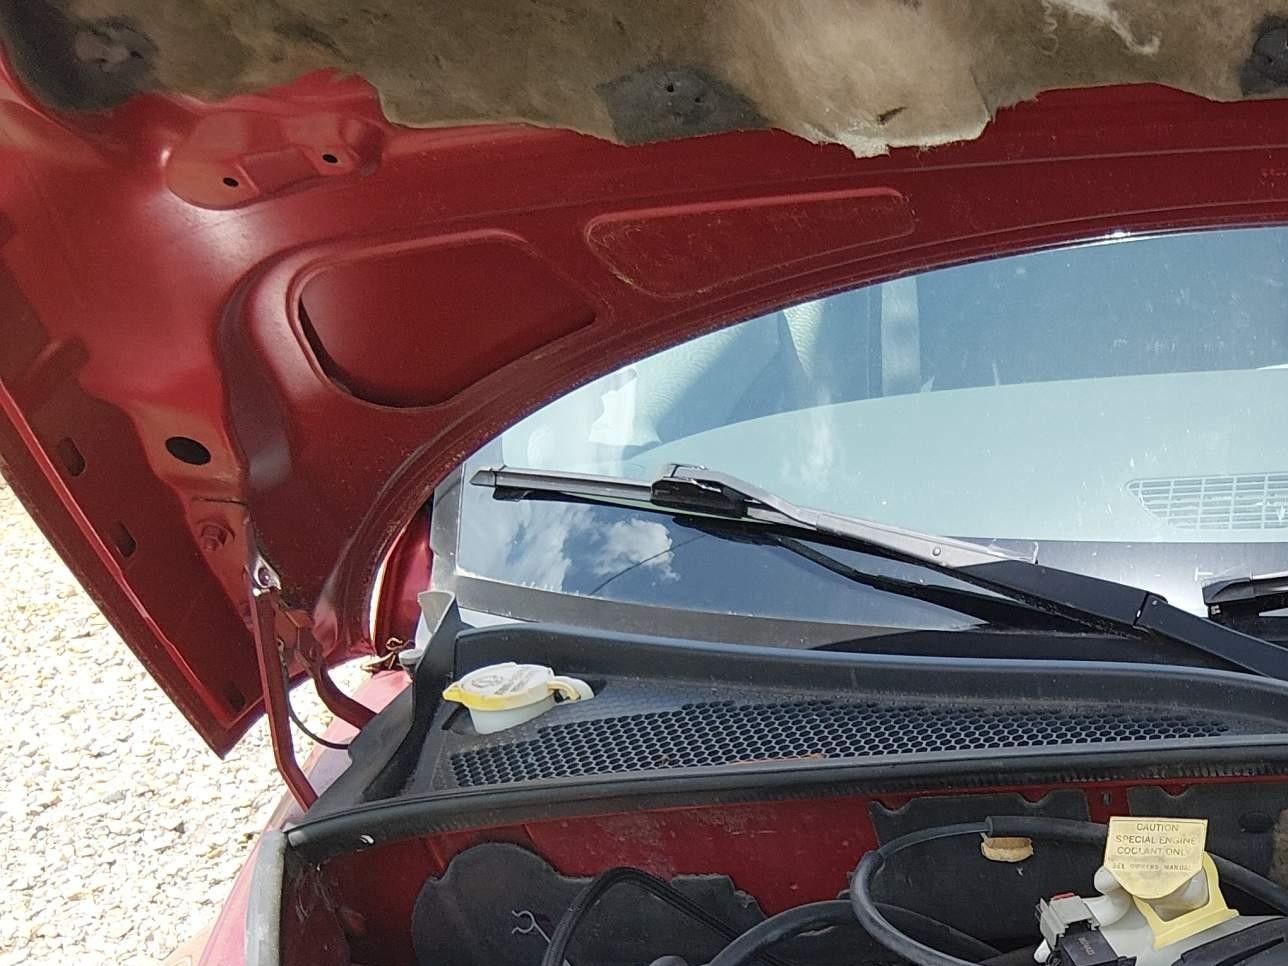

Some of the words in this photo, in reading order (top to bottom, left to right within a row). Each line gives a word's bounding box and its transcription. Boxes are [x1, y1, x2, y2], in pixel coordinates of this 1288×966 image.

[1136, 823, 1180, 832] CAUTION
[1115, 834, 1156, 844] SPECIAL
[1116, 846, 1162, 856] COOLANT
